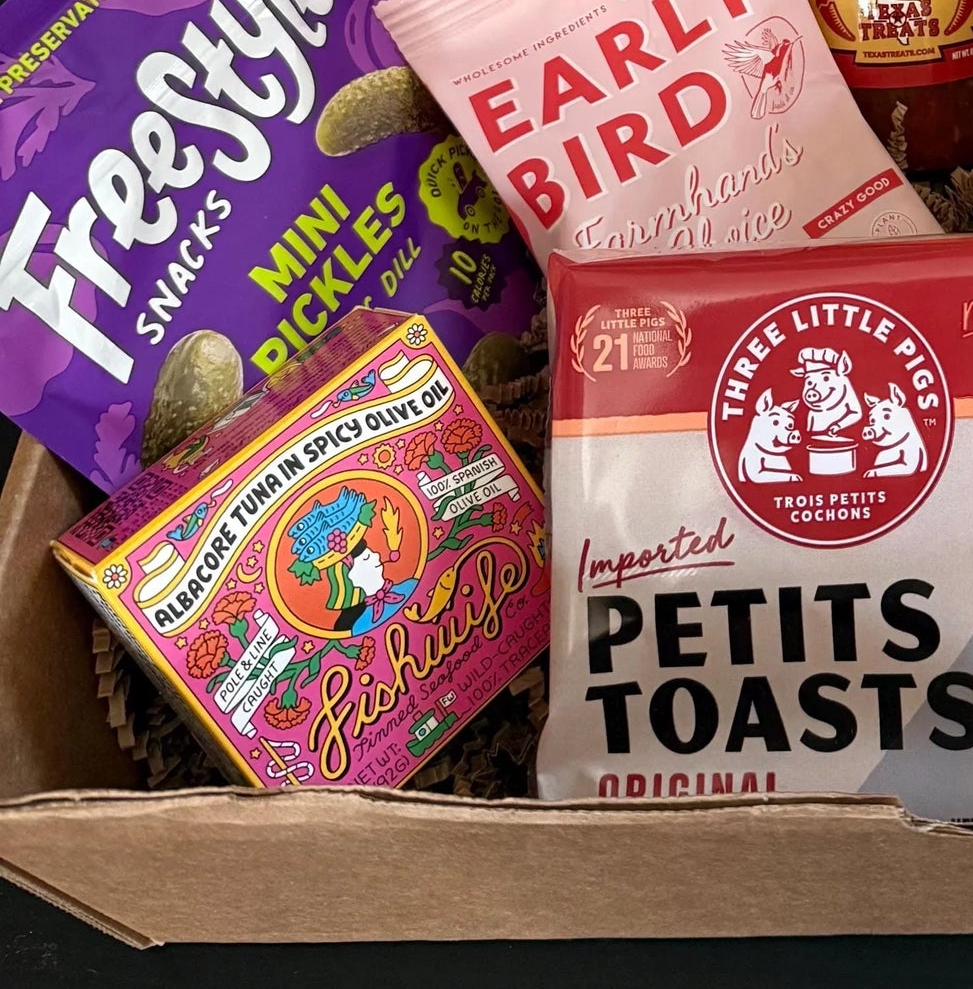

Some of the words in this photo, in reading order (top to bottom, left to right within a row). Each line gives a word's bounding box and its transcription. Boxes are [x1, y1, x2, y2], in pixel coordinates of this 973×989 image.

[452, 48, 531, 88] WHOLESOME
[533, 4, 608, 52] INGREDIENTS
[860, 18, 940, 42] TREATS
[863, 47, 936, 59] TEXASTREATS.COM
[506, 71, 730, 231] BIRD
[425, 154, 448, 199] QUICK
[817, 199, 855, 230] CRAZY
[856, 177, 890, 203] GOOD
[875, 214, 901, 233] PLANT
[247, 183, 351, 304] MINI
[380, 236, 422, 298] DILL
[449, 250, 478, 285] 10
[136, 189, 233, 347] SNACKS
[250, 181, 407, 377] PICKLES
[470, 254, 492, 305] CALORIES
[600, 318, 637, 330] LITTLE
[639, 317, 666, 328] PIGS
[614, 307, 652, 319] THREE
[633, 329, 673, 344] NATIONAL
[592, 333, 629, 372] 21
[632, 356, 669, 370] AWARDS
[633, 343, 655, 357] FOOD
[722, 321, 787, 421] THREE
[791, 303, 895, 344] LITTLE
[893, 336, 940, 411] PIGS
[426, 478, 452, 498] 100%
[453, 457, 499, 486] SPANISH
[448, 493, 482, 515] OLIVE
[483, 484, 502, 500] OIL
[774, 494, 824, 510] TROIS
[829, 490, 887, 506] PETITS
[154, 521, 239, 628] ALBACORE
[230, 473, 283, 528] TUNA
[277, 453, 305, 483] IN
[303, 418, 364, 464] SPICY
[364, 399, 424, 432] OLIVE
[421, 380, 450, 409] OIL
[790, 507, 871, 523] COCHONS
[577, 517, 735, 592] Imported
[419, 635, 483, 701] Seafood
[505, 598, 529, 619] Co.
[456, 599, 550, 693] WILD-CAUGHT
[586, 578, 942, 675] PETITS
[219, 669, 244, 703] POLE
[241, 657, 253, 672] &
[250, 627, 273, 661] LINE
[241, 661, 280, 713] CAUGHT
[441, 692, 456, 706] FW
